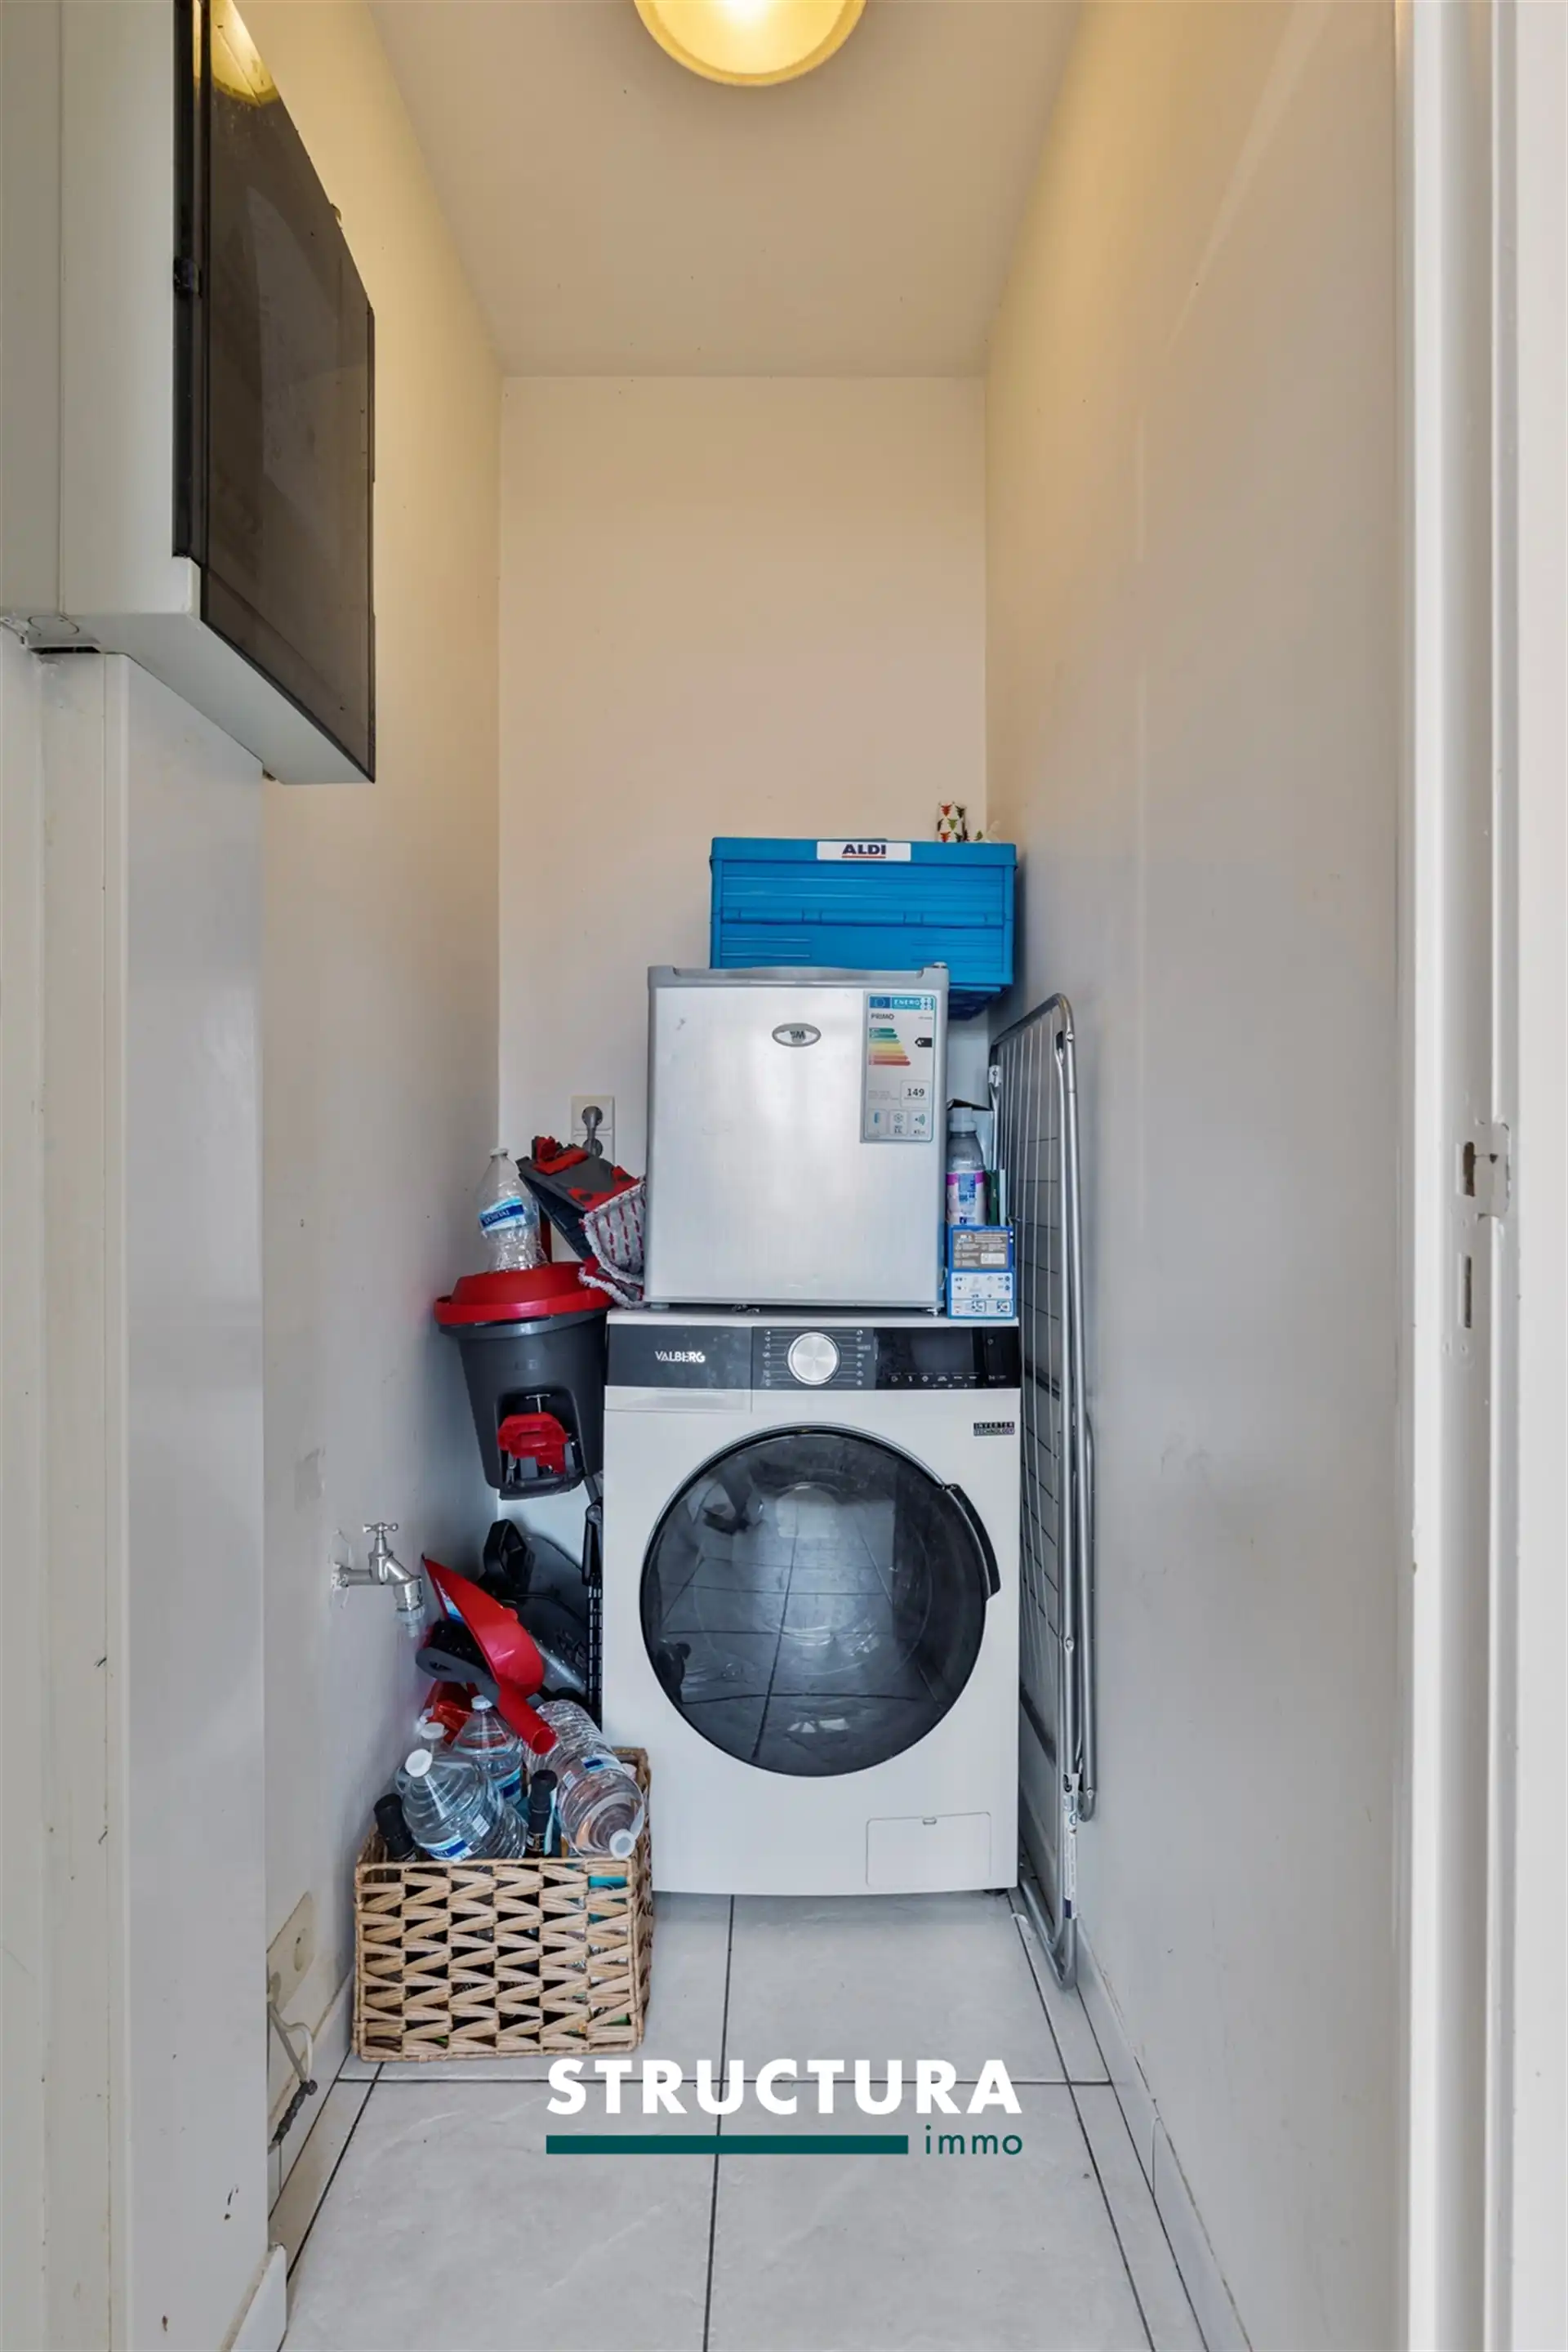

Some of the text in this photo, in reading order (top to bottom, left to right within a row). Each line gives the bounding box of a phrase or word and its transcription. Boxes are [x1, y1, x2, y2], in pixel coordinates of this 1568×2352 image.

[842, 844, 886, 855] ALDI
[906, 1088, 925, 1097] 149
[654, 1351, 706, 1363] VALBERG
